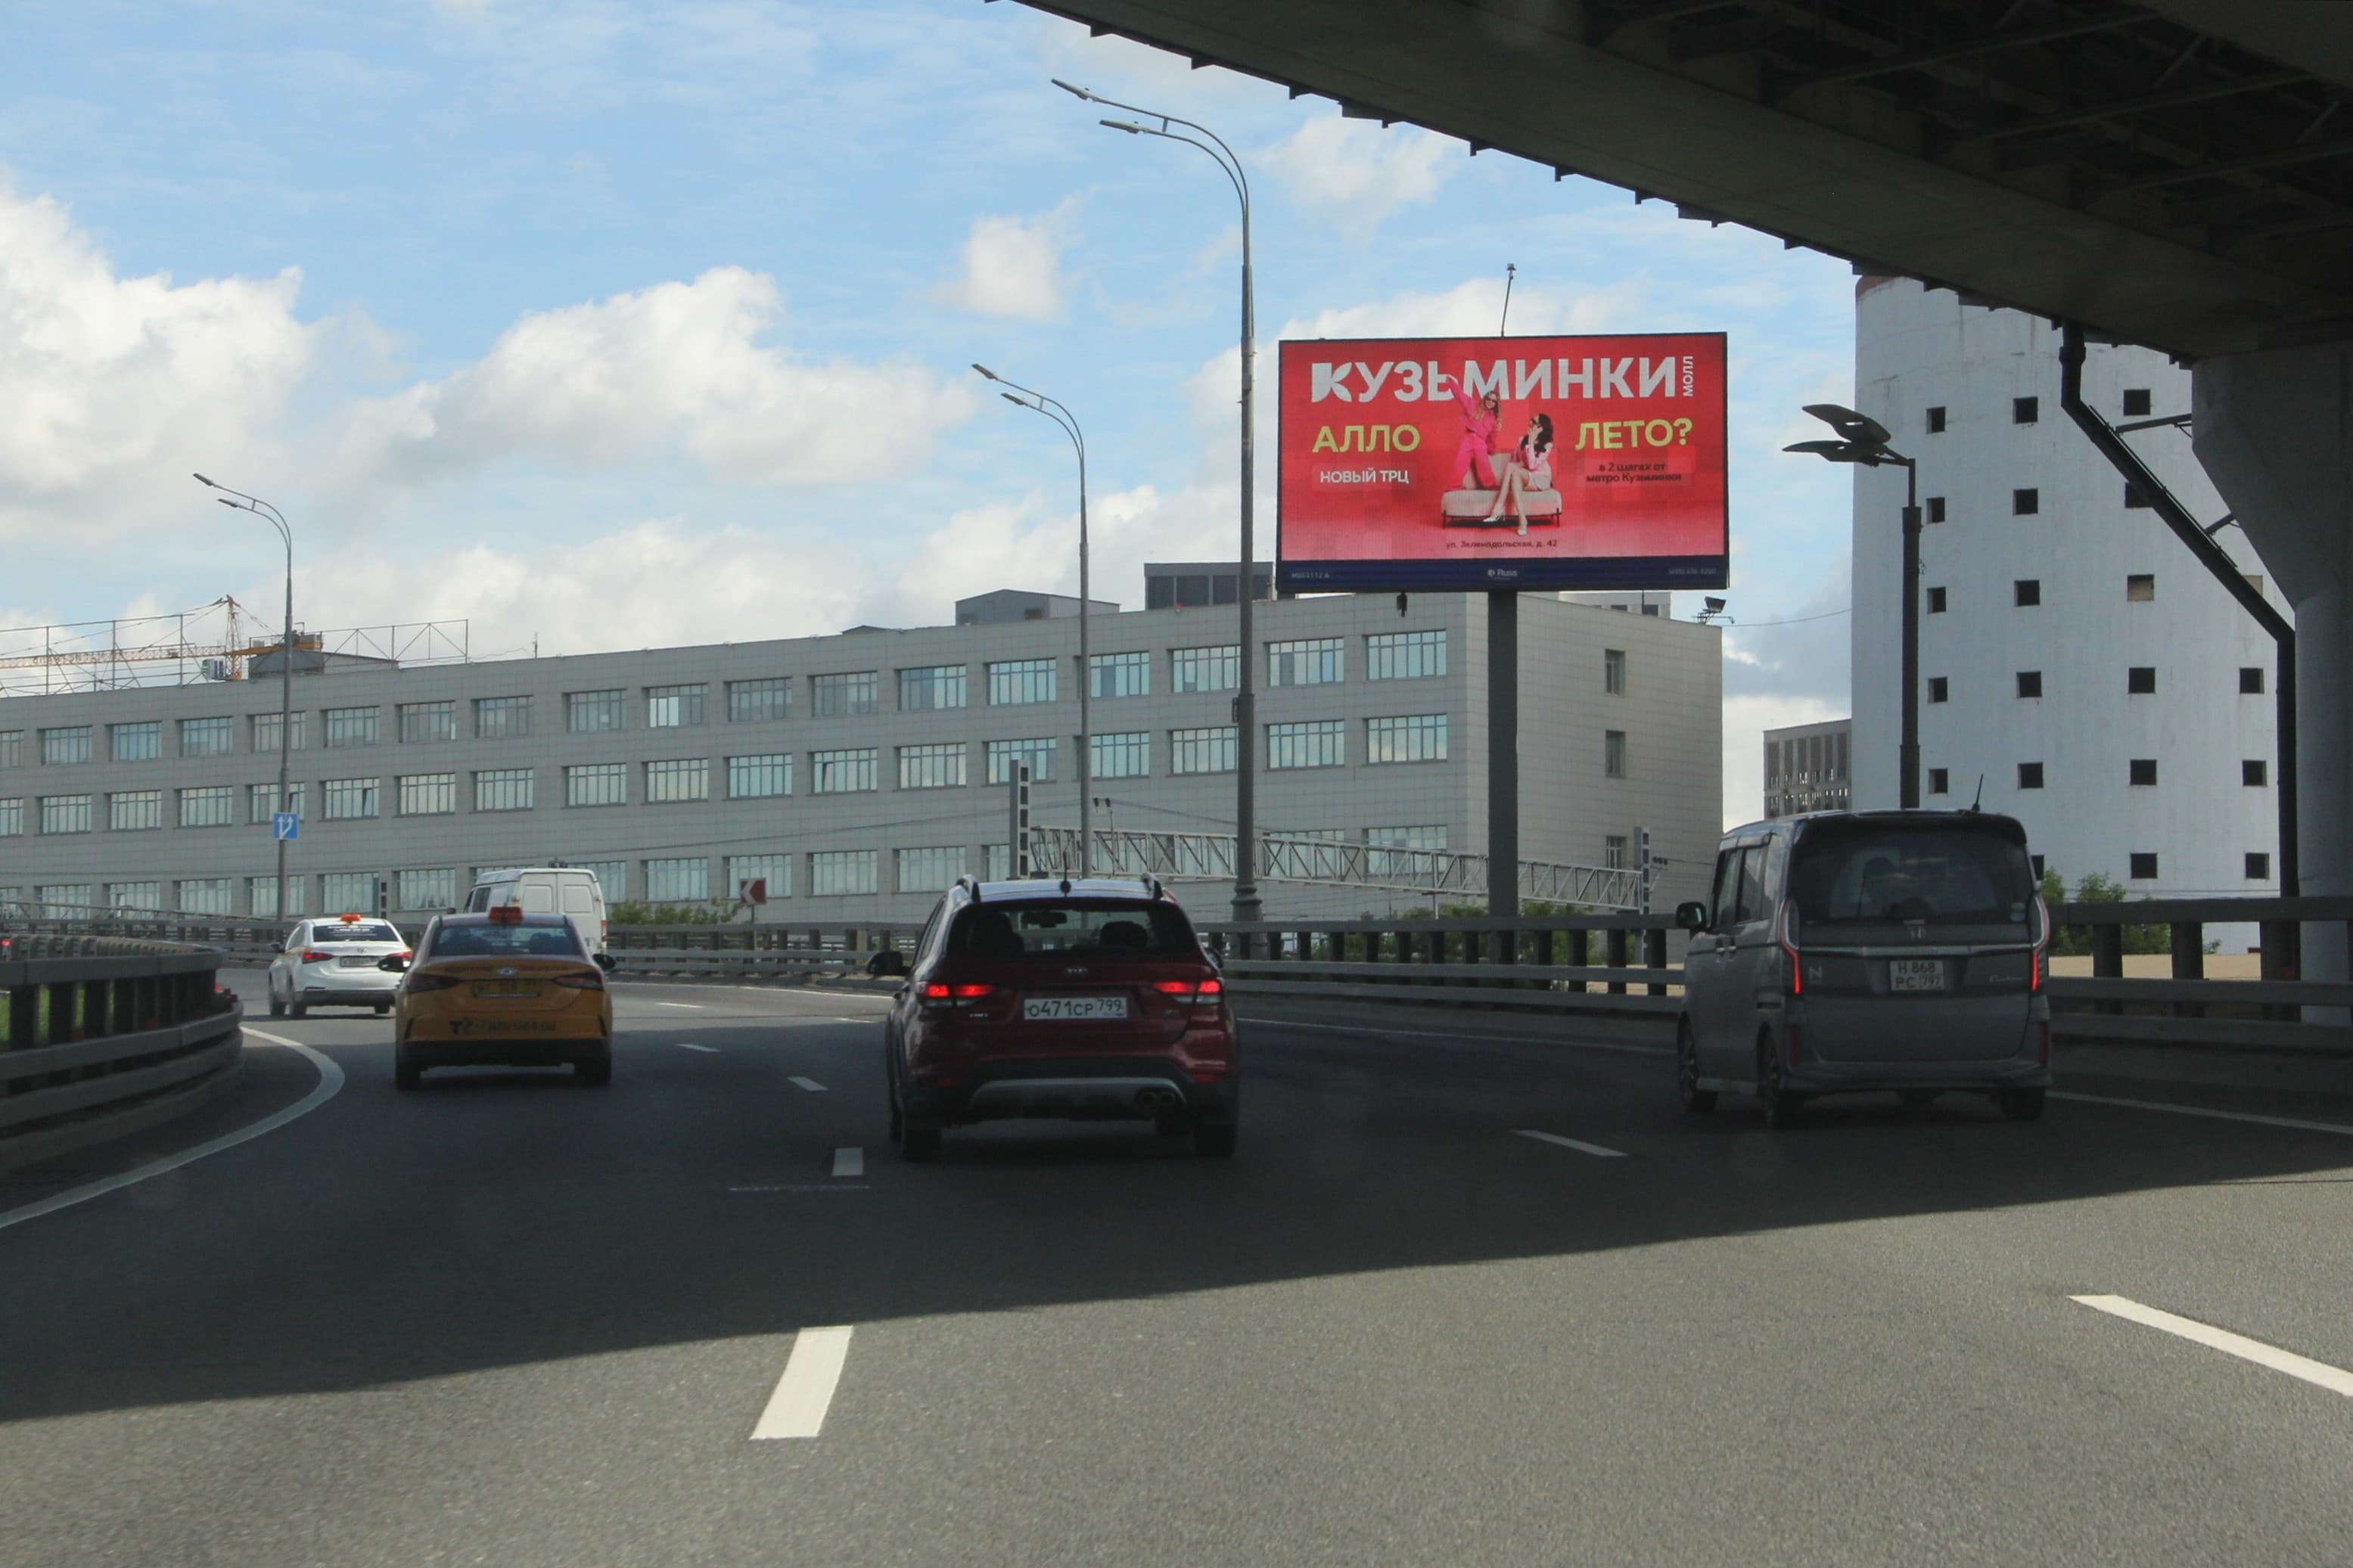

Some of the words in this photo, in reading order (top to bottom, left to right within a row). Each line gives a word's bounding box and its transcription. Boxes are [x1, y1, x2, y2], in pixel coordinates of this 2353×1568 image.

[1311, 356, 1676, 402] КУЗЬМИНКИ
[1683, 356, 1694, 397] МОЛЛ
[1313, 424, 1420, 453] АЛЛО
[1575, 418, 1692, 450] ЛЕТО?
[1320, 467, 1376, 483] НОВЫЙ
[1379, 470, 1410, 483] ТРЦ
[1587, 475, 1620, 484] метро
[1622, 473, 1682, 483] Кузьминки
[1608, 462, 1616, 472] 2
[1618, 463, 1650, 473] шагах
